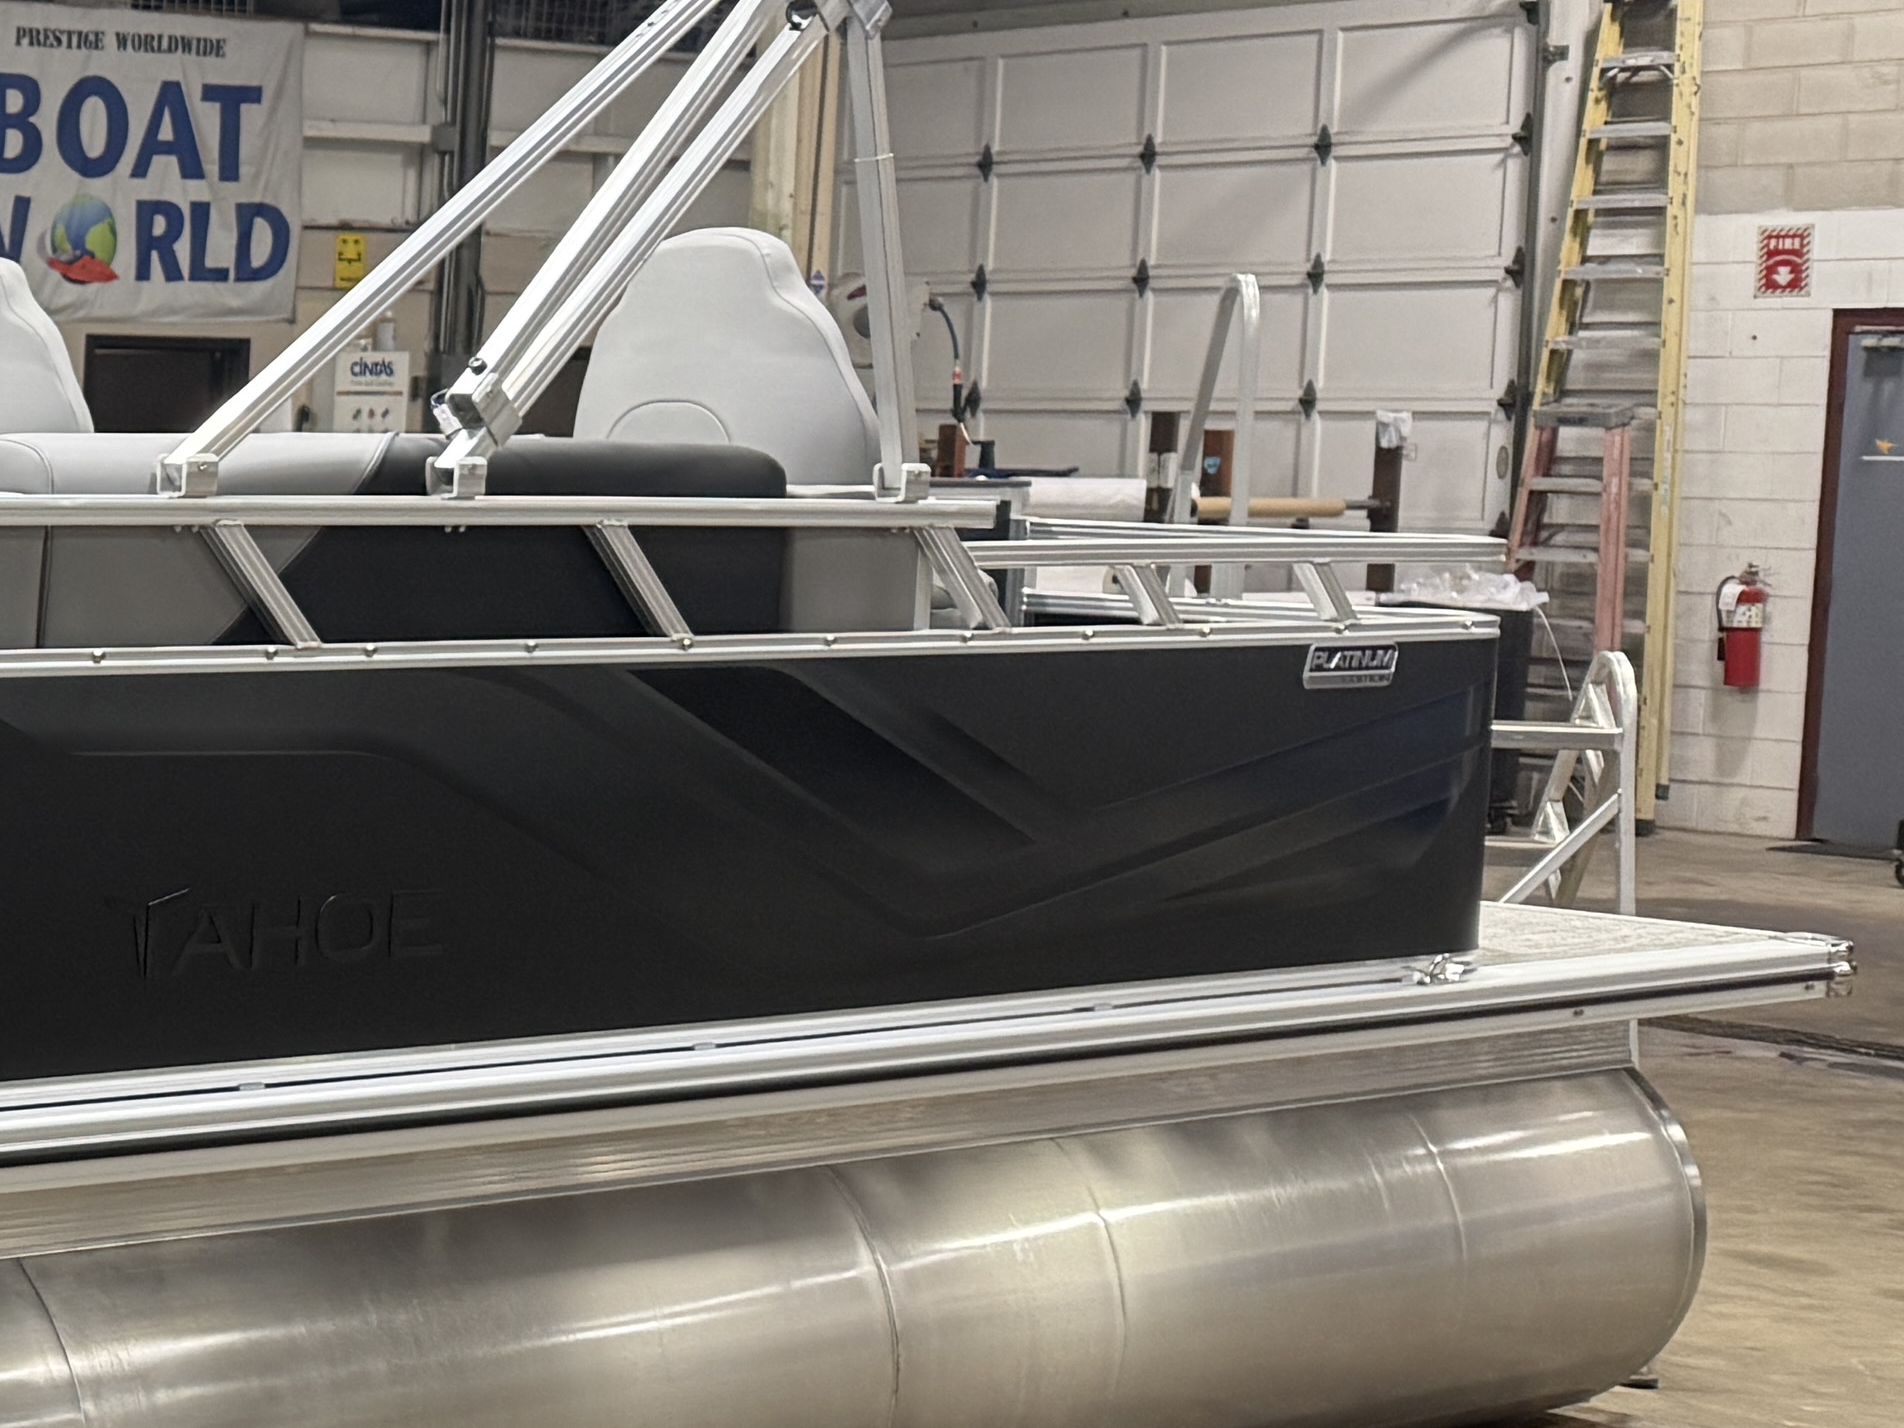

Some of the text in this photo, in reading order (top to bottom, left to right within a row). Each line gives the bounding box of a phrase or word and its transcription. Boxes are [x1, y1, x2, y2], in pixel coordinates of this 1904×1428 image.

[15, 26, 227, 59] PRESTIGE WORLDWIDE
[1769, 237, 1801, 250] FIRE
[1312, 649, 1393, 669] PLATINUM
[102, 886, 442, 979] TAHOE
